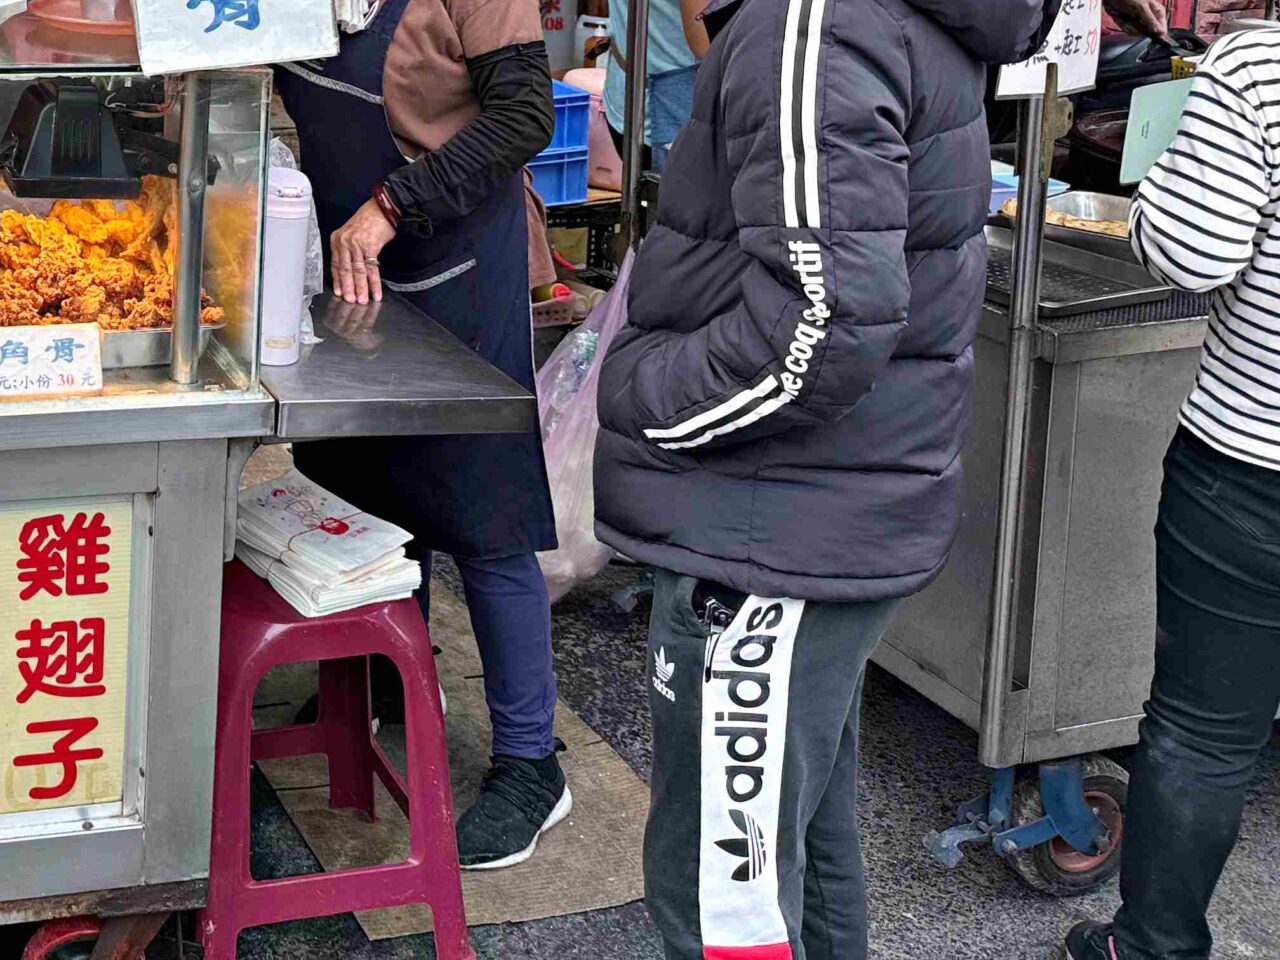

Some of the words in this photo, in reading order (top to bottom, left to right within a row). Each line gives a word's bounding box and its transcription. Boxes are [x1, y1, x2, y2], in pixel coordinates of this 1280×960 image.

[785, 323, 826, 374] coq
[652, 676, 676, 702] adidas
[713, 602, 784, 803] adidas
